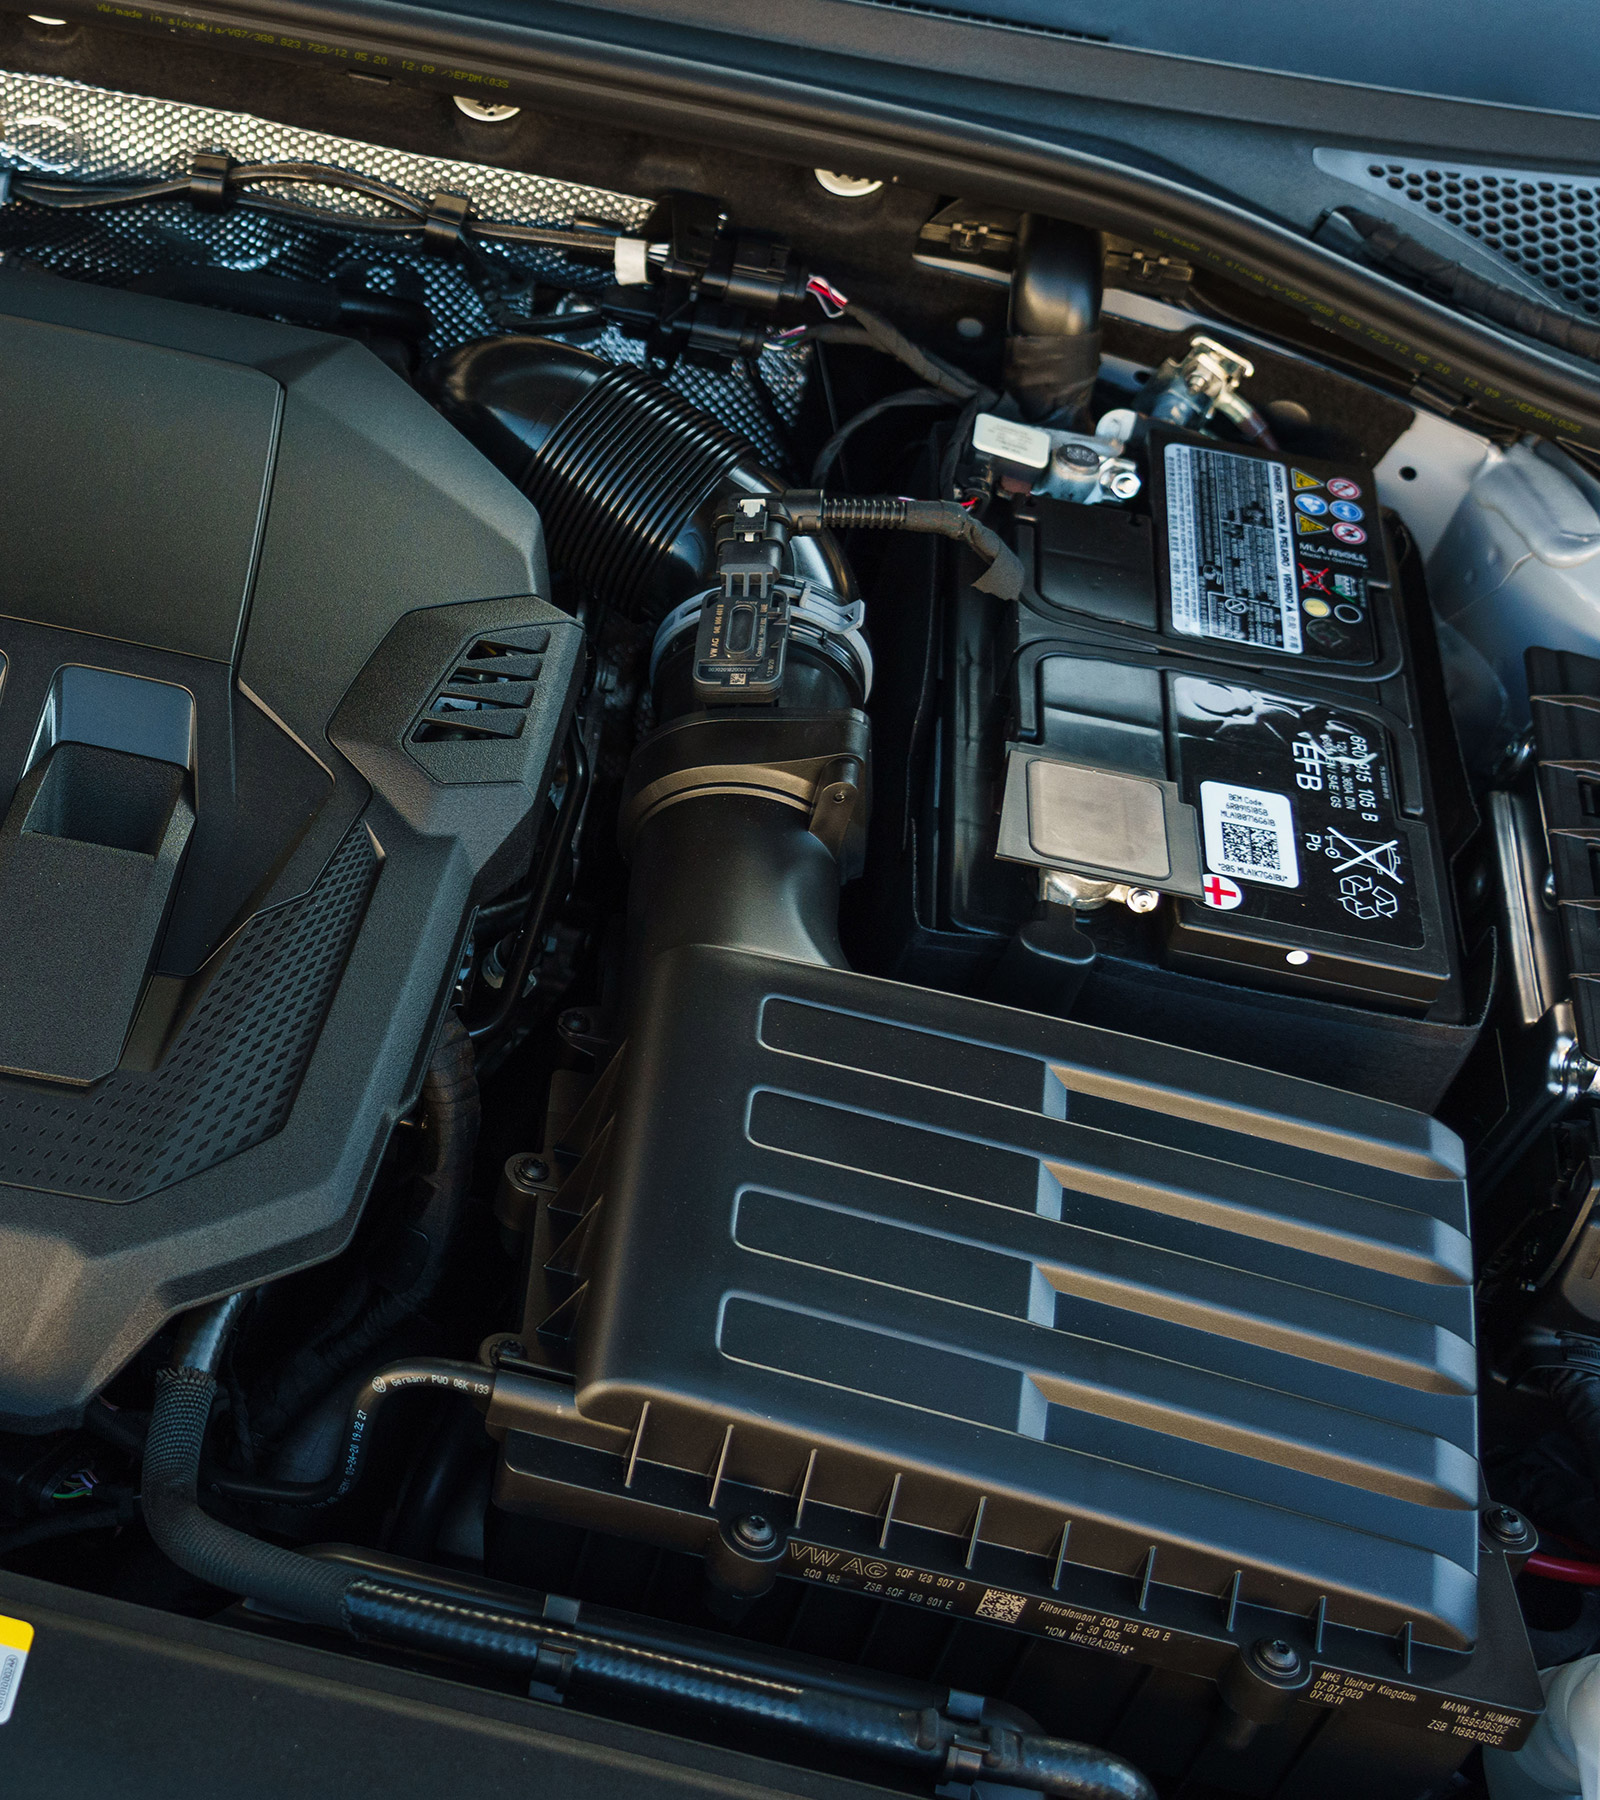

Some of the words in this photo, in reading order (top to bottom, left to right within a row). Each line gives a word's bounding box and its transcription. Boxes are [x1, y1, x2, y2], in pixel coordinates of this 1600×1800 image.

[1349, 734, 1368, 759] 6R0
[1292, 741, 1323, 792] EFB
[1328, 773, 1339, 791] SAE
[1228, 793, 1243, 803] BEM
[1331, 796, 1342, 809] GS
[1344, 795, 1356, 811] DIN
[1358, 788, 1376, 809] 105
[1362, 812, 1380, 823] B
[1305, 833, 1321, 851] Pb
[390, 1375, 427, 1386] Germany
[431, 1374, 449, 1385] PWO
[453, 1378, 470, 1391] 06K
[473, 1383, 490, 1394] 133
[357, 1409, 368, 1421] 27
[790, 1542, 840, 1568] VW
[840, 1557, 888, 1579] AG
[803, 1567, 822, 1580] 5Q0
[895, 1567, 915, 1579] 5QF
[918, 1573, 933, 1584] 129
[956, 1582, 966, 1592] D
[863, 1581, 882, 1593] ZSB
[885, 1586, 905, 1598] 5QF
[908, 1592, 923, 1603] 129
[945, 1600, 954, 1610] E
[1038, 1601, 1096, 1624] Filterelement
[1099, 1617, 1120, 1629] 5Q0
[1123, 1623, 1139, 1634] 129
[1162, 1632, 1171, 1642] B
[1075, 1621, 1084, 1632] C
[1086, 1624, 1100, 1635] 30
[1103, 1628, 1121, 1641] 005
[1313, 1681, 1364, 1700] 07.07.2020
[1320, 1671, 1342, 1683] MH3
[1343, 1677, 1375, 1692] United
[1377, 1683, 1417, 1702] Kingdom
[1309, 1690, 1344, 1705] 07:10:11
[1440, 1700, 1470, 1715] MANN
[1473, 1709, 1480, 1717] +
[1485, 1711, 1522, 1728] HUMMEL
[1427, 1719, 1448, 1732] ZSB
